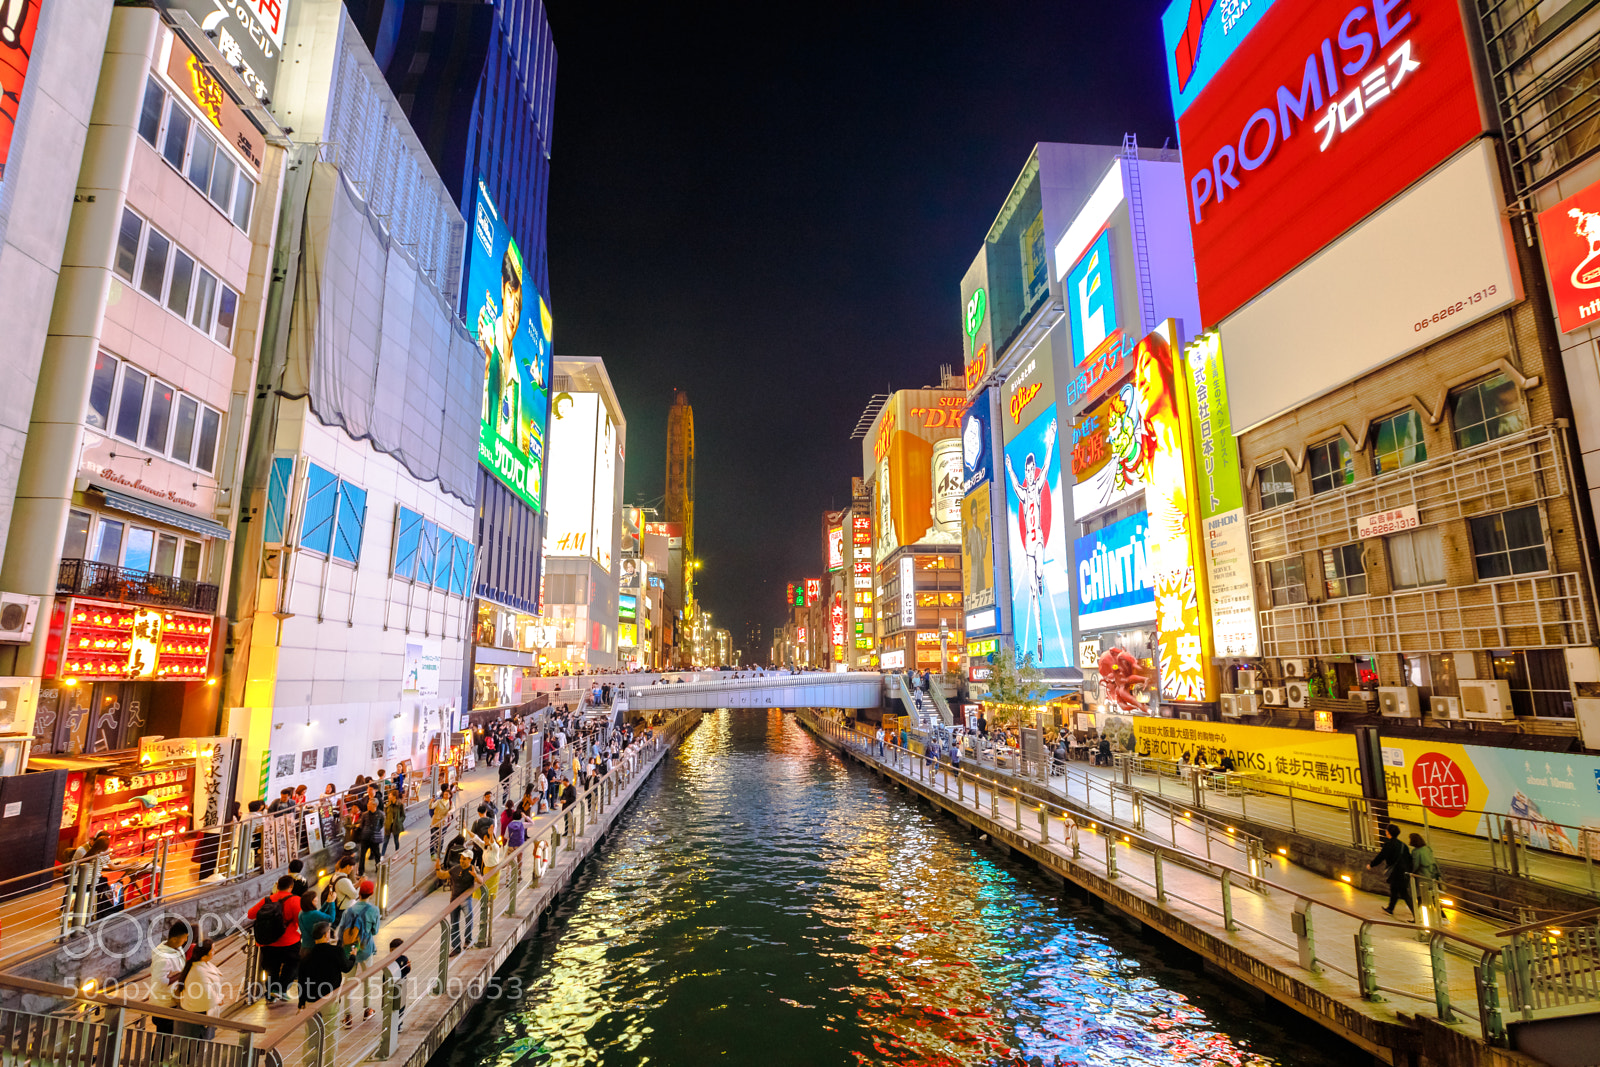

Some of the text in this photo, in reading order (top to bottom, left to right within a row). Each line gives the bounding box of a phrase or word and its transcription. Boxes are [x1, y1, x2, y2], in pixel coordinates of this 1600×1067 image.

[1314, 39, 1421, 153] プロミス
[1191, 0, 1412, 224] PROMISE
[1414, 284, 1498, 333] 06-6262-1313
[964, 343, 987, 391] ピップ
[1009, 382, 1043, 426] Glico
[1072, 415, 1100, 445] かぜに
[1070, 430, 1105, 476] 改源
[1208, 513, 1238, 530] NIHON
[1360, 517, 1416, 538] 06-6262-1313
[1369, 510, 1403, 526] 広告募集
[35, 701, 145, 735] やすべえ
[1315, 711, 1332, 723] BAR
[1418, 760, 1455, 783] TAX
[1526, 775, 1548, 786] about
[1418, 784, 1467, 808] FREE!
